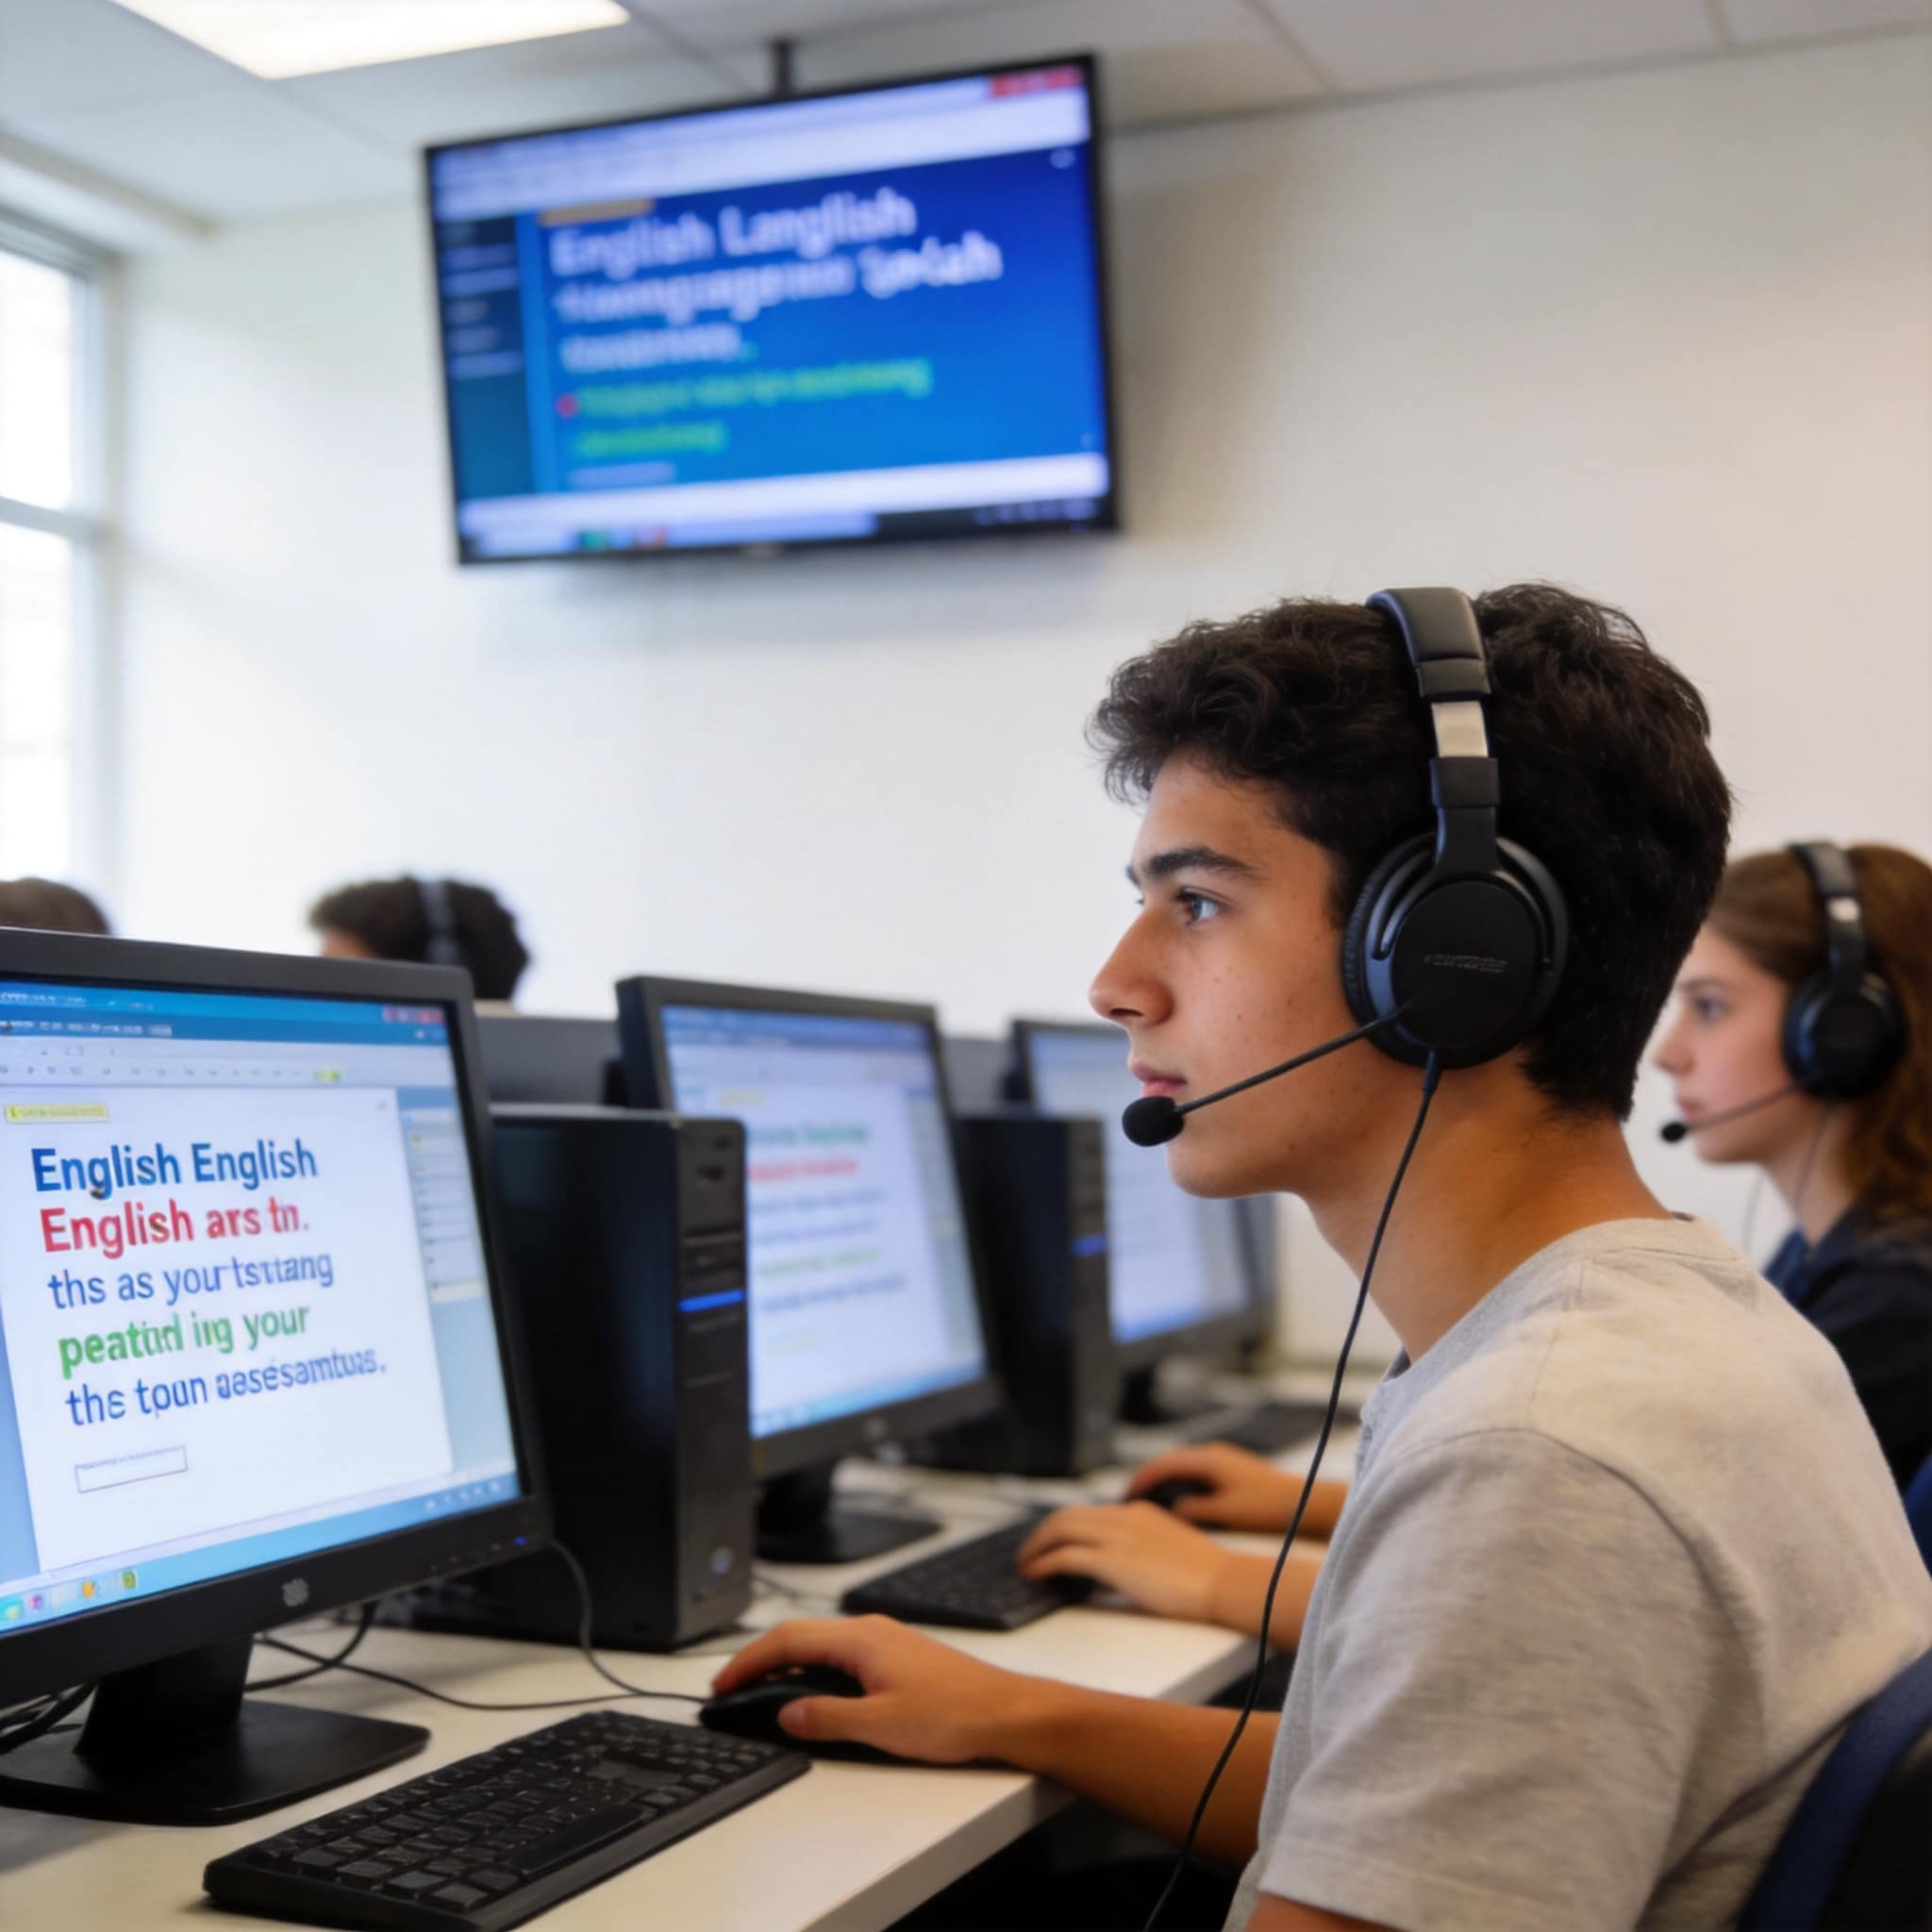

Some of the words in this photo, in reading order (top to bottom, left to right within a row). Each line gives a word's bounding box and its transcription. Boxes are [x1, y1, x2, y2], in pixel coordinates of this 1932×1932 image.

[31, 1142, 182, 1201] English
[191, 1139, 318, 1191] English
[40, 1198, 194, 1260] English
[118, 1272, 155, 1301] as
[242, 1306, 310, 1351] your
